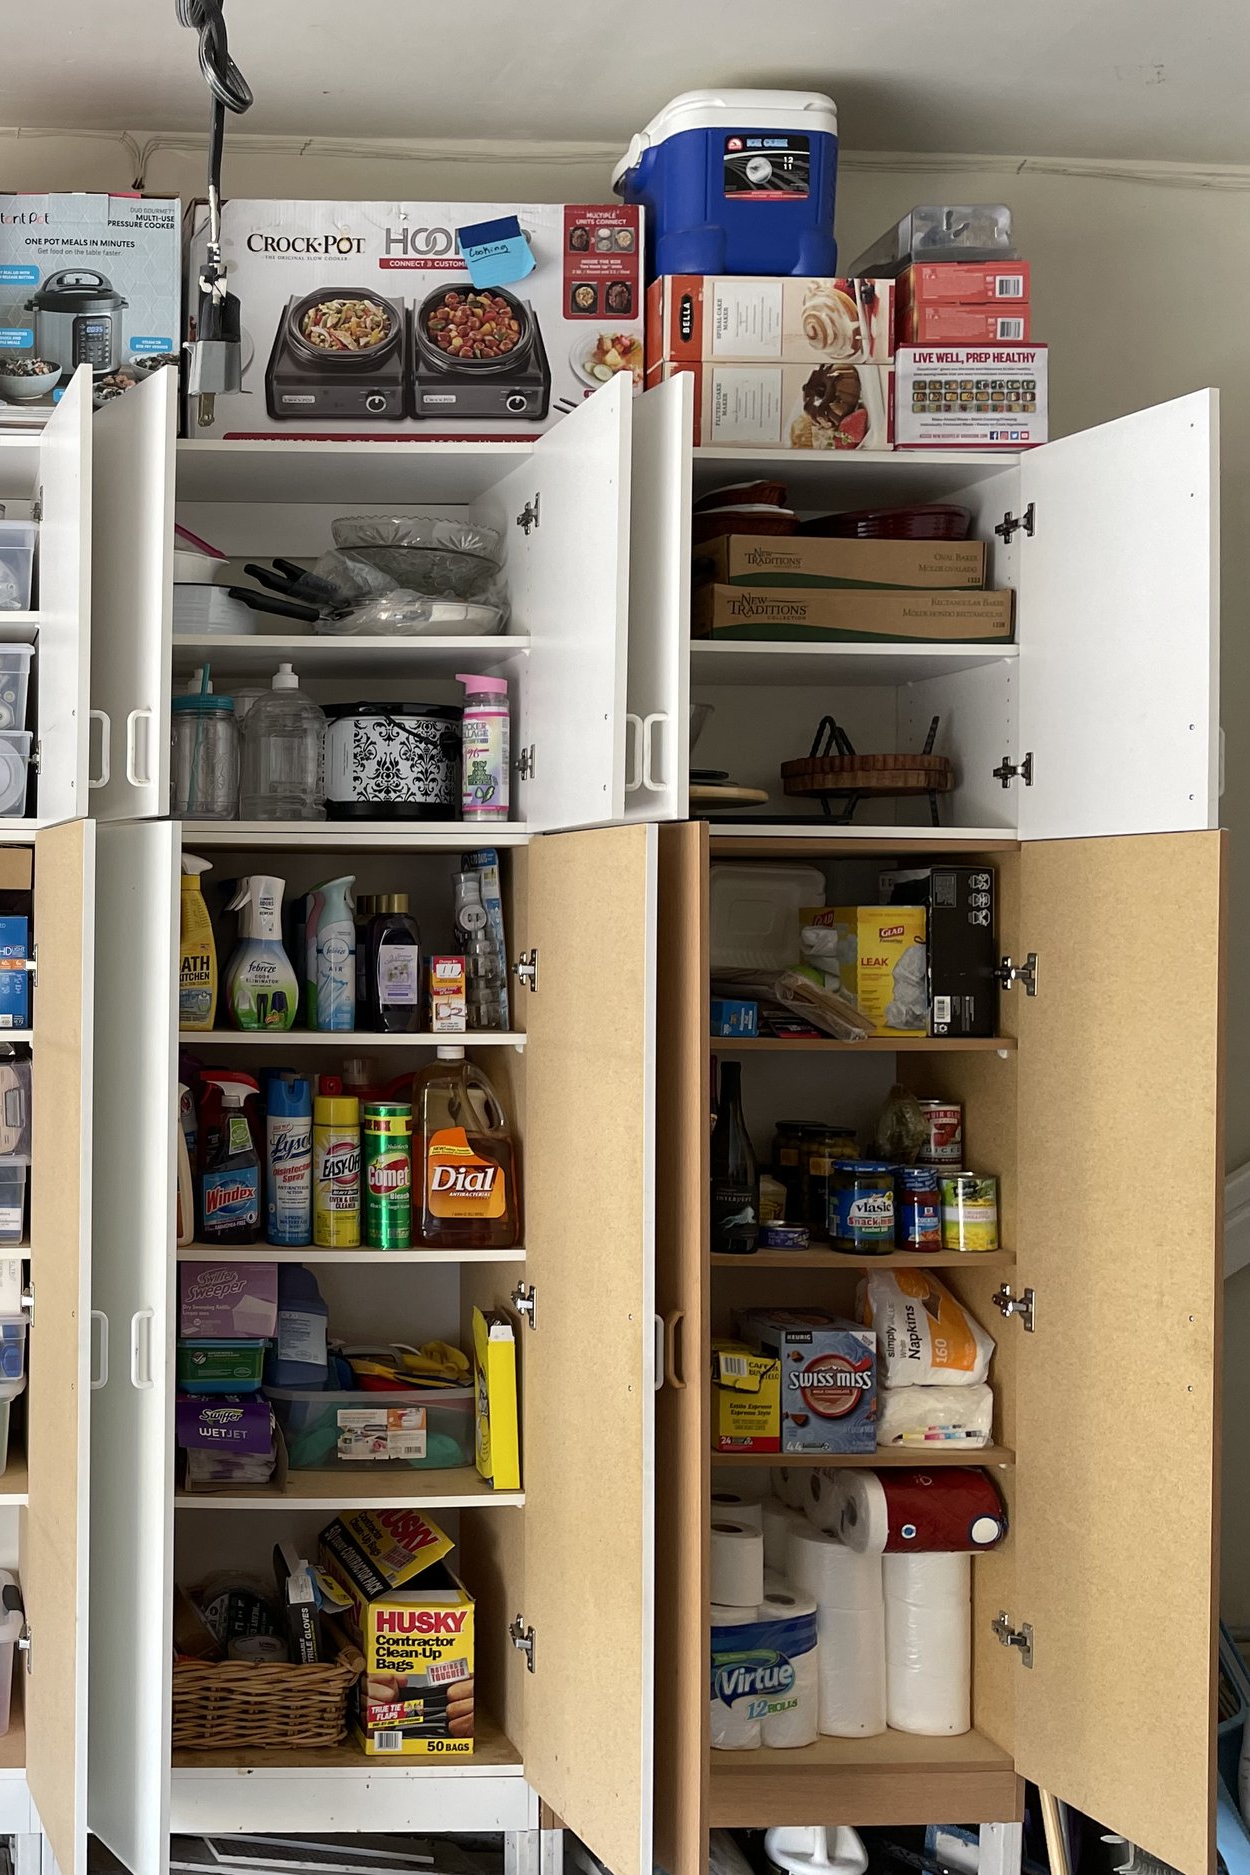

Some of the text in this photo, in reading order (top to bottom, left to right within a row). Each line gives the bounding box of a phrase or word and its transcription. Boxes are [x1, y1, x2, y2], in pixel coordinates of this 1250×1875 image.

[29, 211, 50, 224] Pot
[135, 214, 175, 222] MULTI-USE
[108, 220, 175, 230] PRESSURE COOKER
[24, 238, 42, 246] ONE
[44, 238, 60, 246] POT
[62, 238, 88, 246] MEALS
[100, 240, 135, 248] MINUTES
[389, 260, 425, 268] CONNECT
[682, 302, 691, 333] BELLA
[913, 352, 1036, 365] LIVE WELL, PREP HEALTHY
[744, 552, 801, 566] TRADITIONS
[740, 592, 767, 606] NEW
[727, 600, 807, 616] TRADITIONS
[880, 927, 903, 938] GLAD
[248, 960, 276, 973] febreze
[861, 957, 889, 967] LEAK
[282, 1173, 306, 1184] Spray
[368, 1165, 410, 1186] Comet
[431, 1166, 495, 1191] Dial
[205, 1184, 256, 1215] Windex
[389, 1192, 410, 1200] Bleach
[856, 1202, 892, 1213] vlasic
[197, 1268, 238, 1286] Swiffer
[186, 1280, 247, 1303] Sweeper
[908, 1305, 921, 1360] Napkins
[887, 1324, 896, 1358] simply
[935, 1338, 947, 1364] 160
[789, 1372, 872, 1390] SWISS MISS
[199, 1408, 244, 1424] Swiffer
[362, 1576, 384, 1595] PACK
[302, 1607, 310, 1640] GLOVES
[377, 1610, 468, 1633] HUSKY
[376, 1634, 456, 1648] Contractor
[376, 1658, 415, 1673] Bags
[720, 1662, 794, 1696] Virtue
[371, 1704, 402, 1714] TRUE TIE
[747, 1699, 798, 1720] 12 ROLLS
[376, 1712, 398, 1721] FLAPS
[427, 1741, 470, 1751] 50 BAGS
